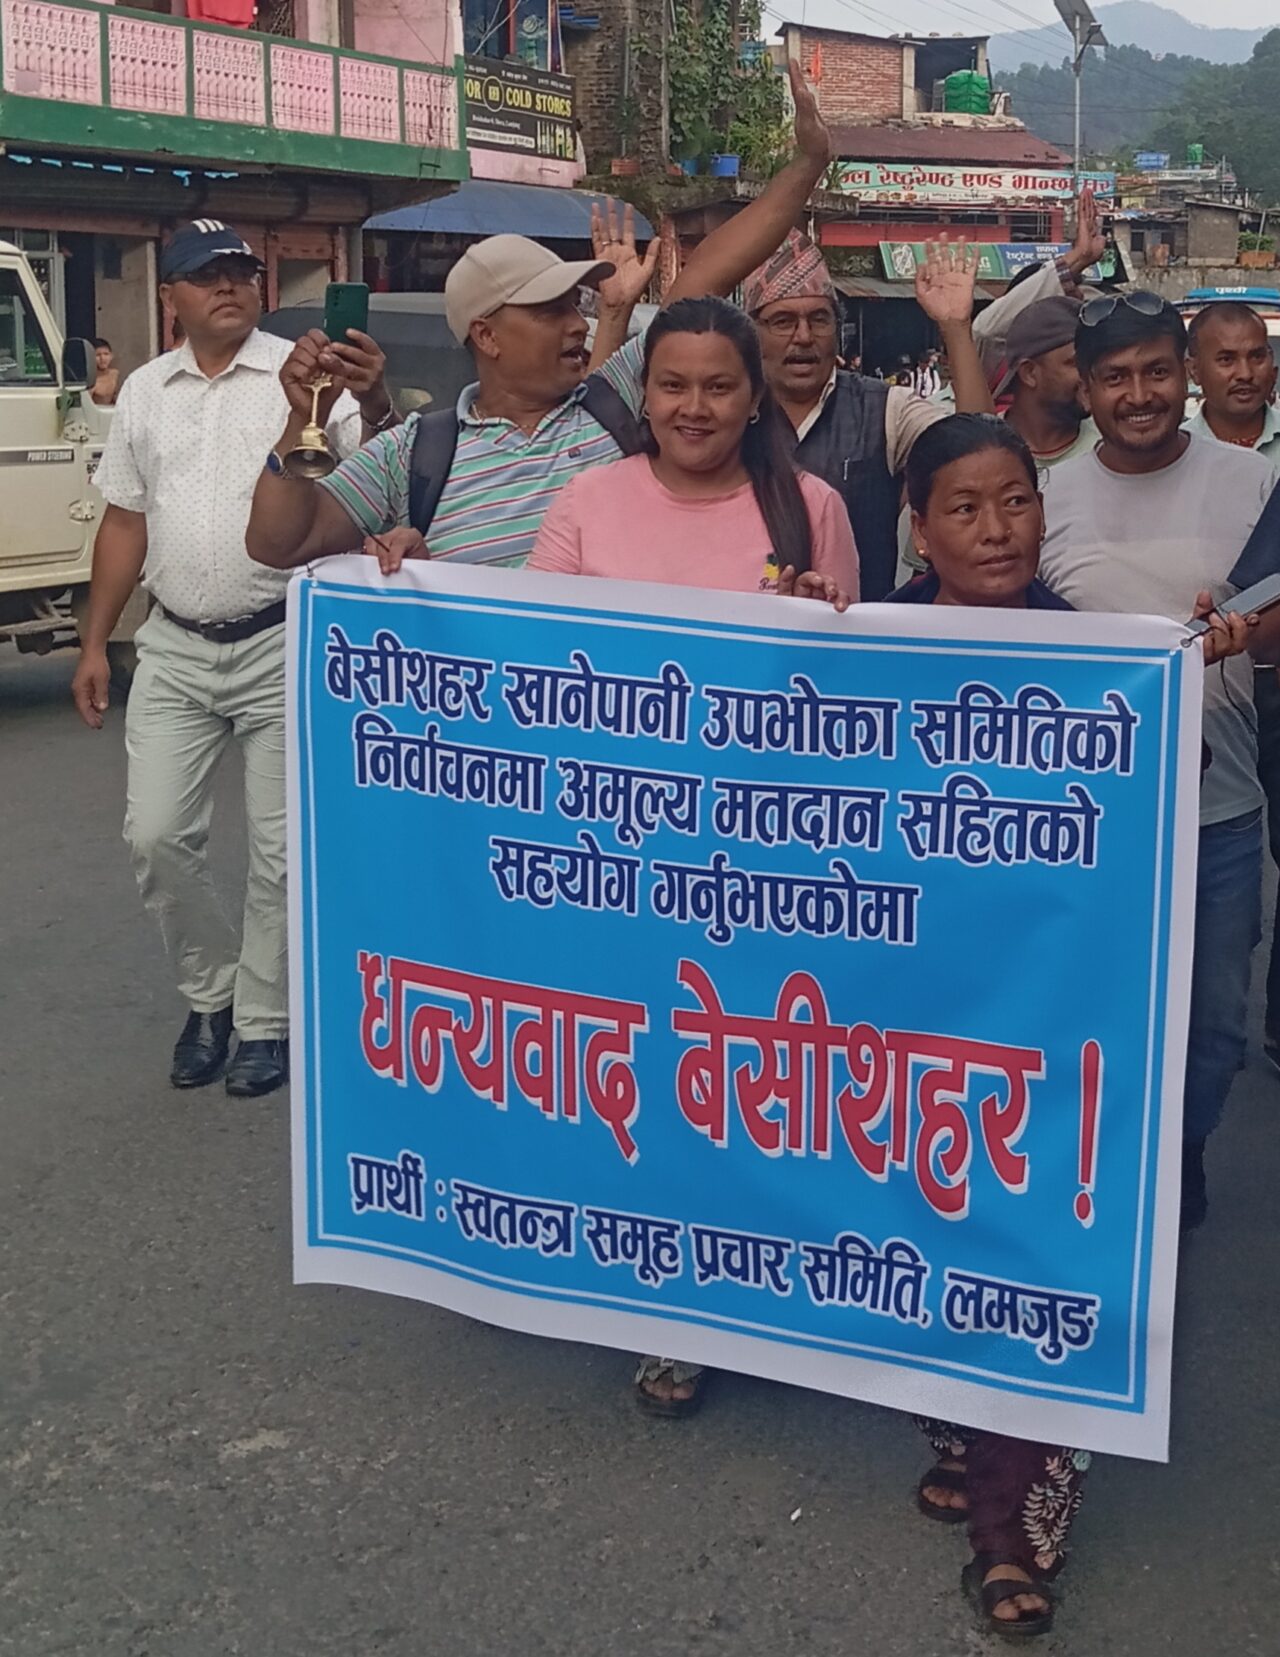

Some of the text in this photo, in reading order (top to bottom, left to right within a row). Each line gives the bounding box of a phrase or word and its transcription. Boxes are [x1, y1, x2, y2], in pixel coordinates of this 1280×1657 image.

[506, 87, 532, 109] COLD
[535, 93, 573, 118] STORES
[326, 626, 1138, 774] बेसीशहर खानेपानी उपभोक्ता समितिको
[354, 713, 1102, 867] निर्वाचनमा अमूल्य मतदान सहितको
[490, 832, 919, 944] सहयोग गर्नुभएकोमा
[357, 951, 1103, 1228] धन्यवाद बेसीशहर !
[350, 1153, 424, 1219] प्रार्थी
[453, 1182, 575, 1254] स्वतन्त्र
[586, 1208, 680, 1284] समूह
[692, 1226, 792, 1293] प्रचार
[945, 1271, 1097, 1360] लमजुङ
